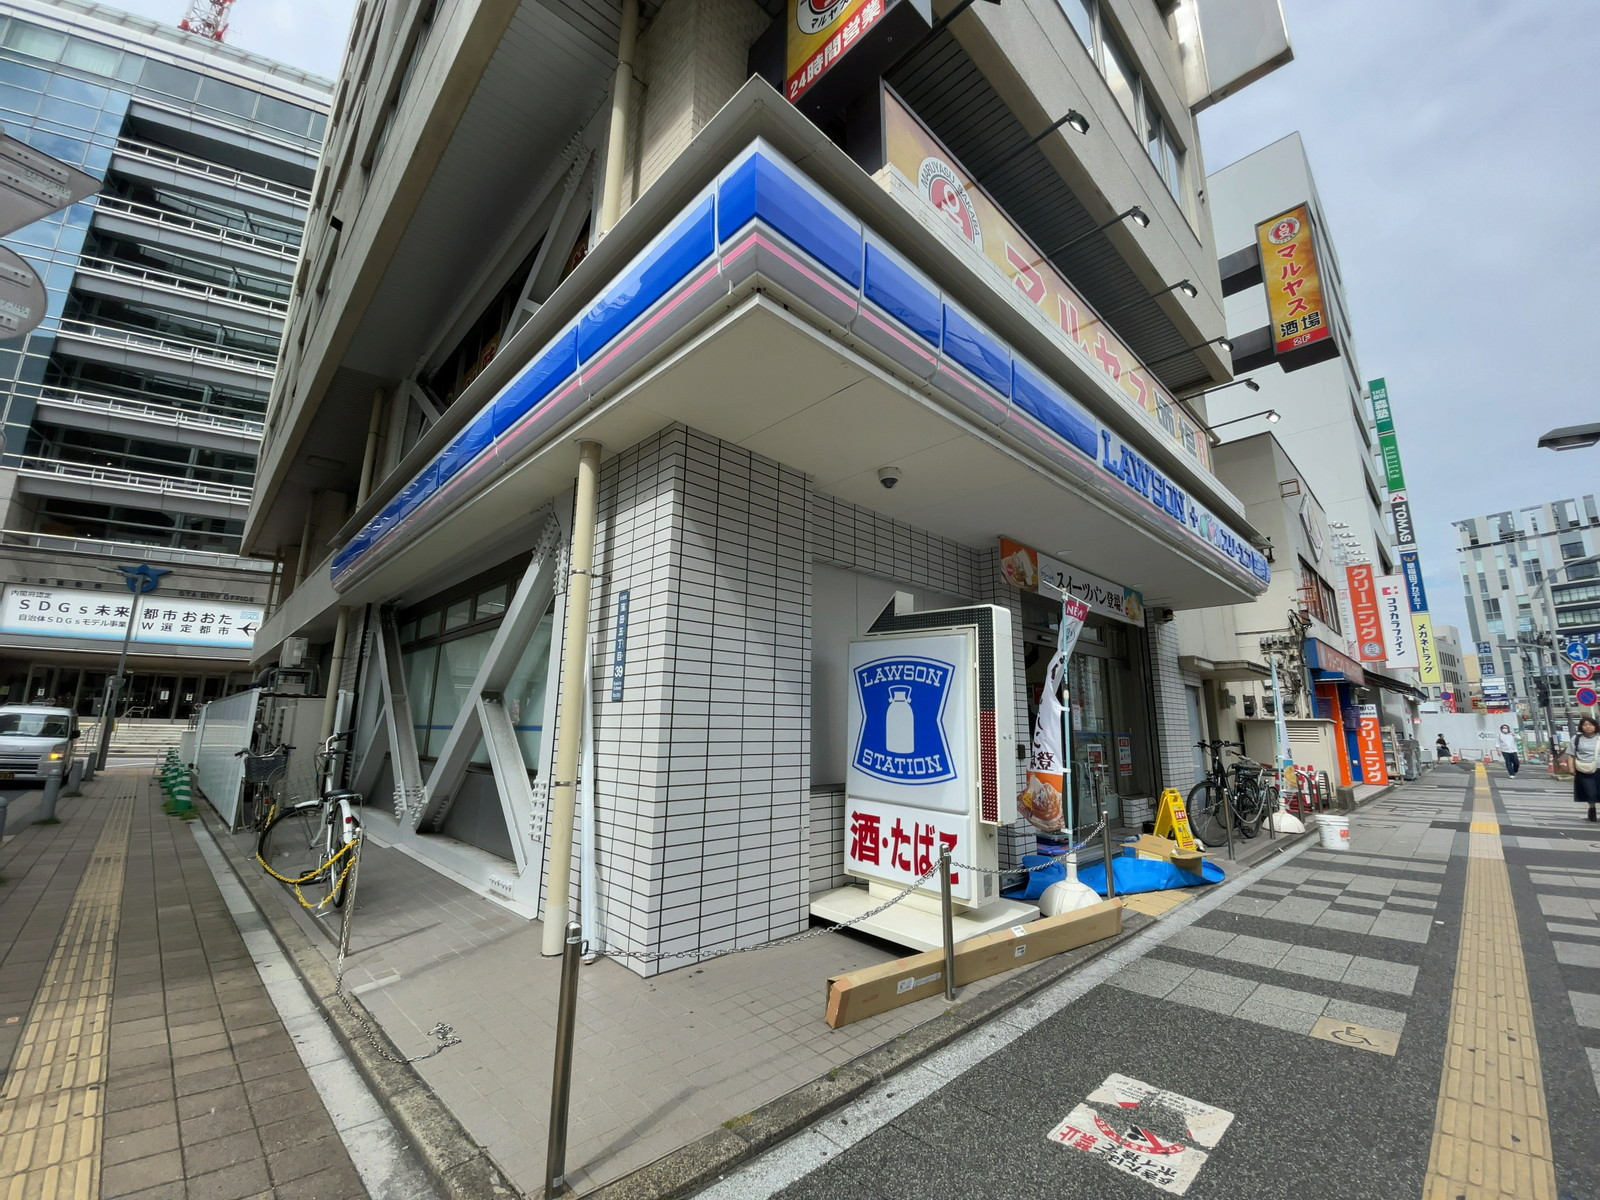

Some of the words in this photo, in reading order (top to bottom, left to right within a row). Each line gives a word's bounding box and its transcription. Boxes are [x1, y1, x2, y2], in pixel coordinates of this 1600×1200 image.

[790, 0, 881, 99] 24時間営業
[920, 161, 955, 189] MARUYASU
[1276, 242, 1309, 317] マルヤス
[1280, 311, 1321, 338] 酒場
[1293, 334, 1311, 346] 2F
[1101, 429, 1187, 525] LAWSON
[1394, 504, 1412, 543] TOMAS
[1066, 605, 1085, 620] NEW
[1352, 568, 1377, 640] クリーニング
[1387, 597, 1406, 657] ココカラファイン
[861, 663, 943, 688] LAWSON
[862, 748, 944, 776] STATION
[1360, 719, 1382, 782] クリーニング
[1059, 1124, 1099, 1151] 禁止
